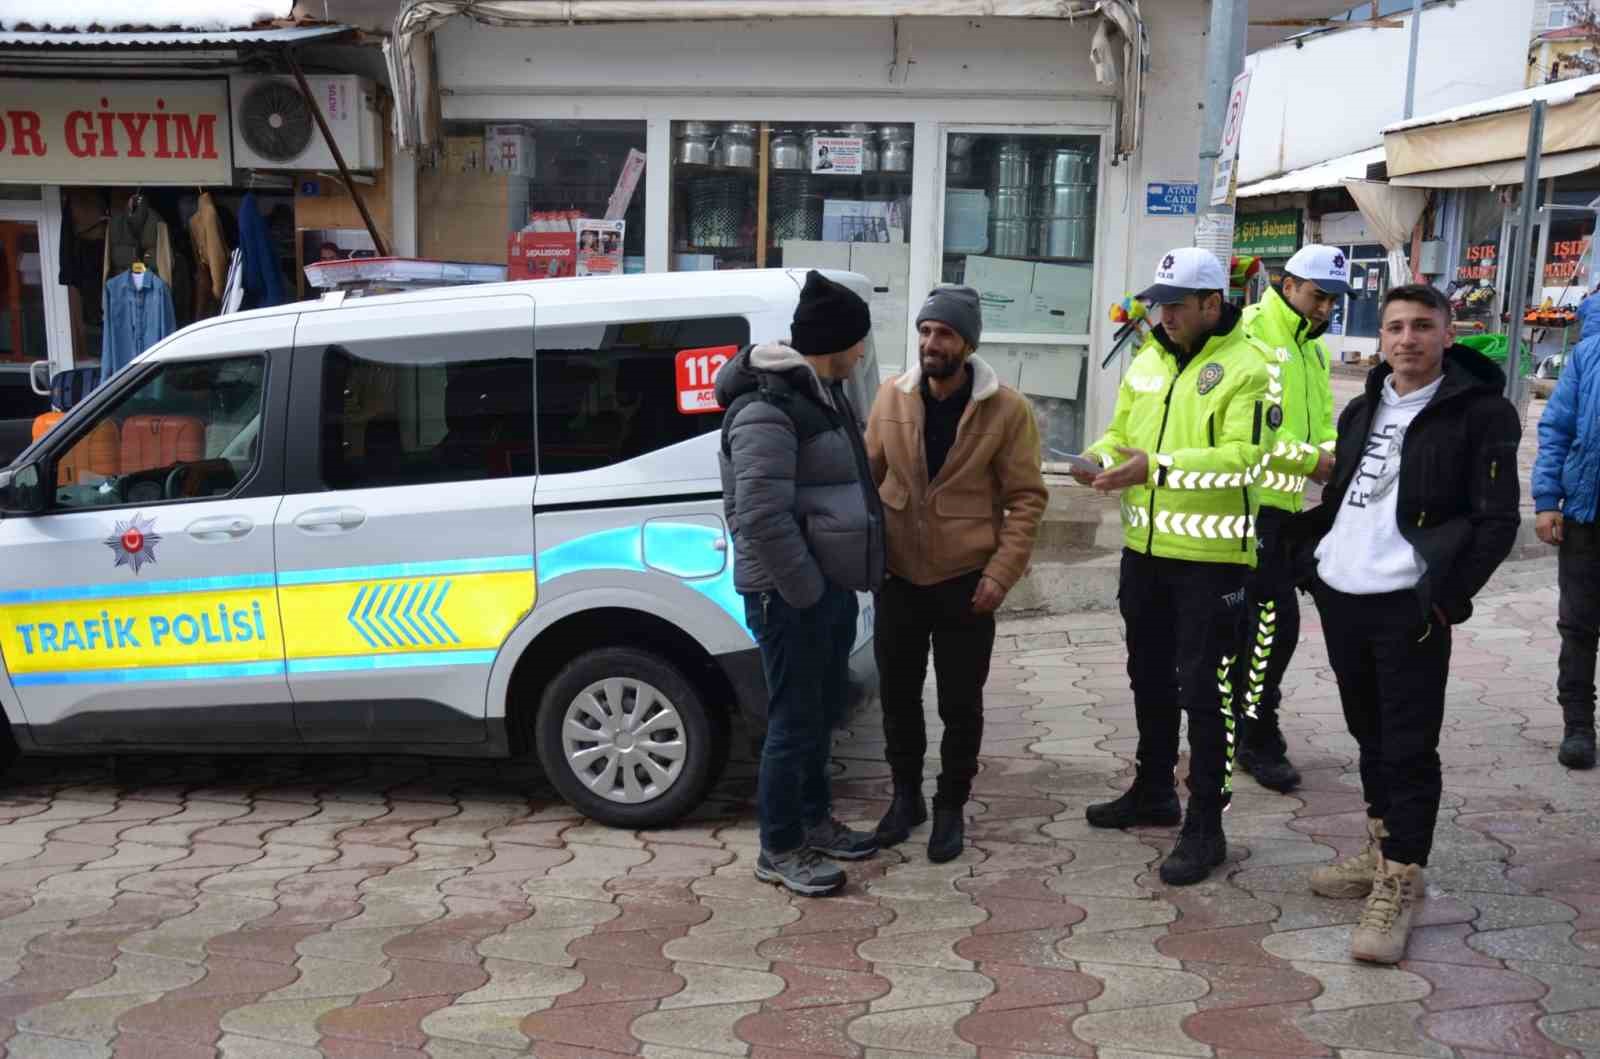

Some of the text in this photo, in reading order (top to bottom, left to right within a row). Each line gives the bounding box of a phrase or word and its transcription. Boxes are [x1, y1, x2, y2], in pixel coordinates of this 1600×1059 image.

[0, 97, 218, 159] R GİYİM
[685, 354, 728, 386] 112
[16, 600, 266, 654] TRAFİK POLİSİ
